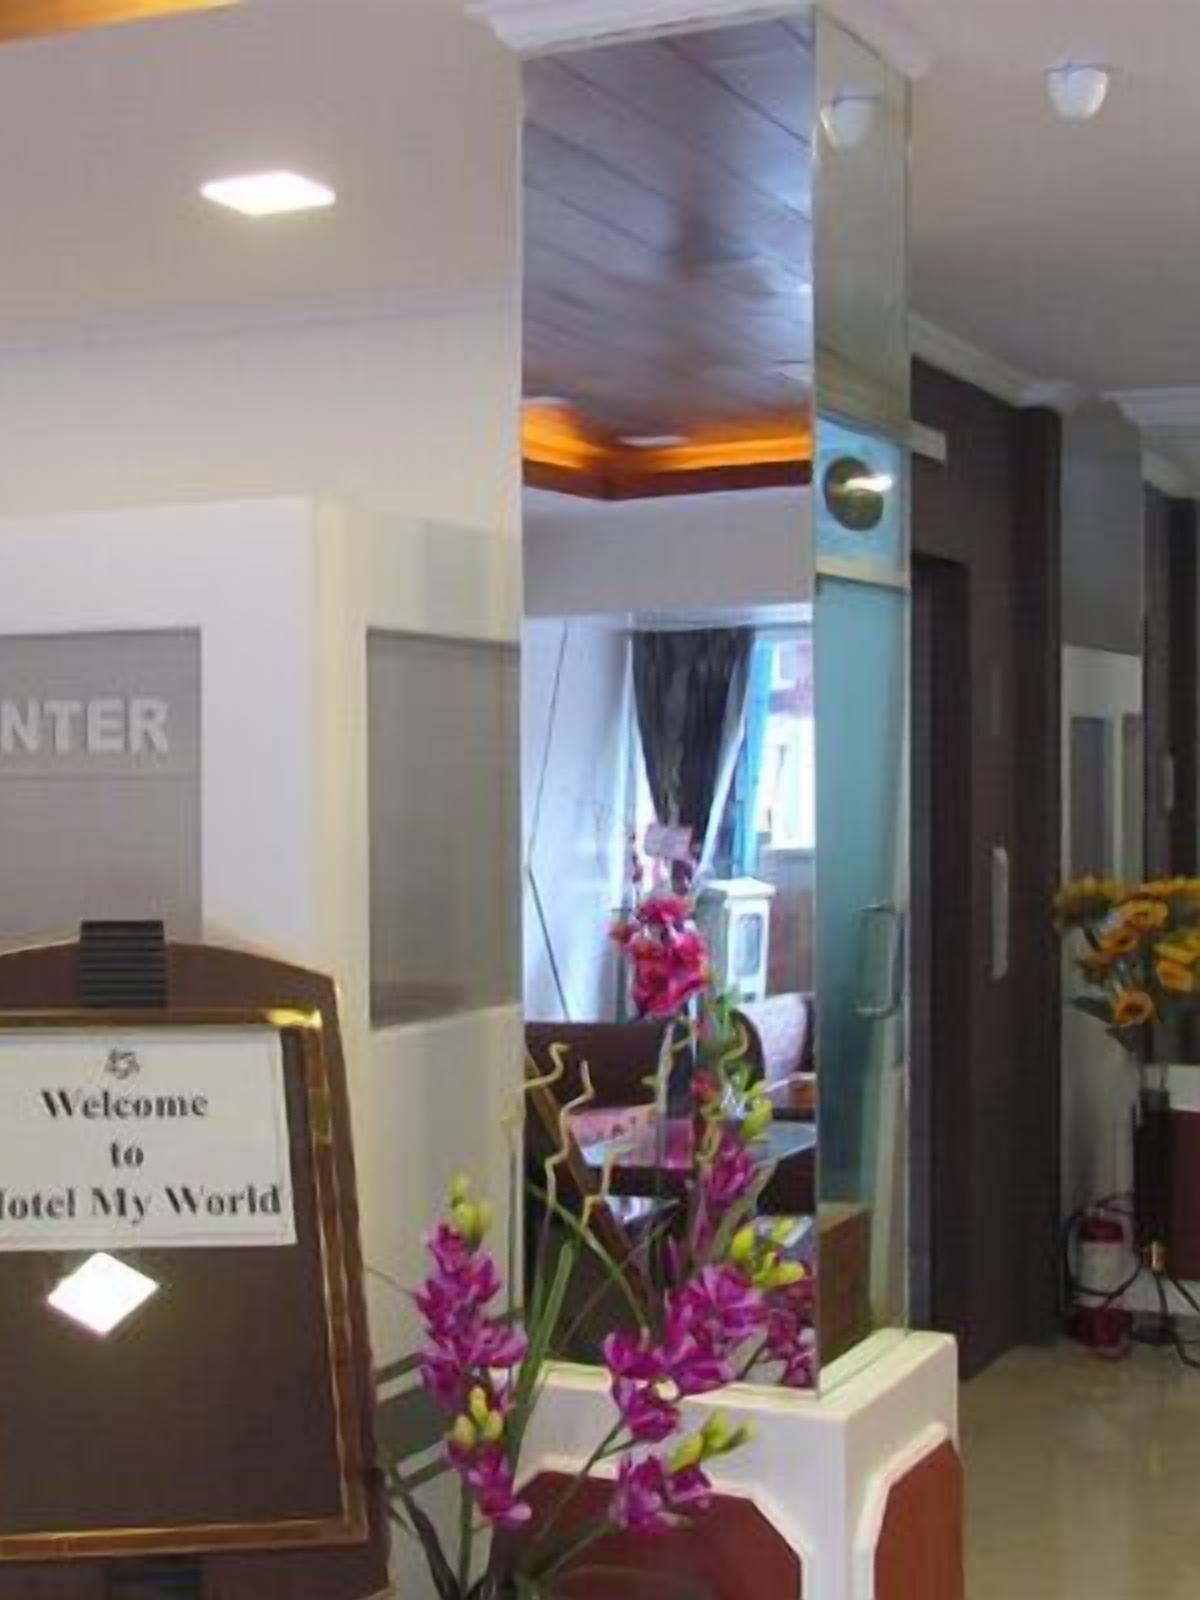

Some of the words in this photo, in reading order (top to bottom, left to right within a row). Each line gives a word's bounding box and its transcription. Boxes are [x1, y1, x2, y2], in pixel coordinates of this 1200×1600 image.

[41, 1088, 209, 1120] Welcome
[109, 1141, 145, 1168] to
[91, 1186, 146, 1227] My
[164, 1184, 282, 1217] World
